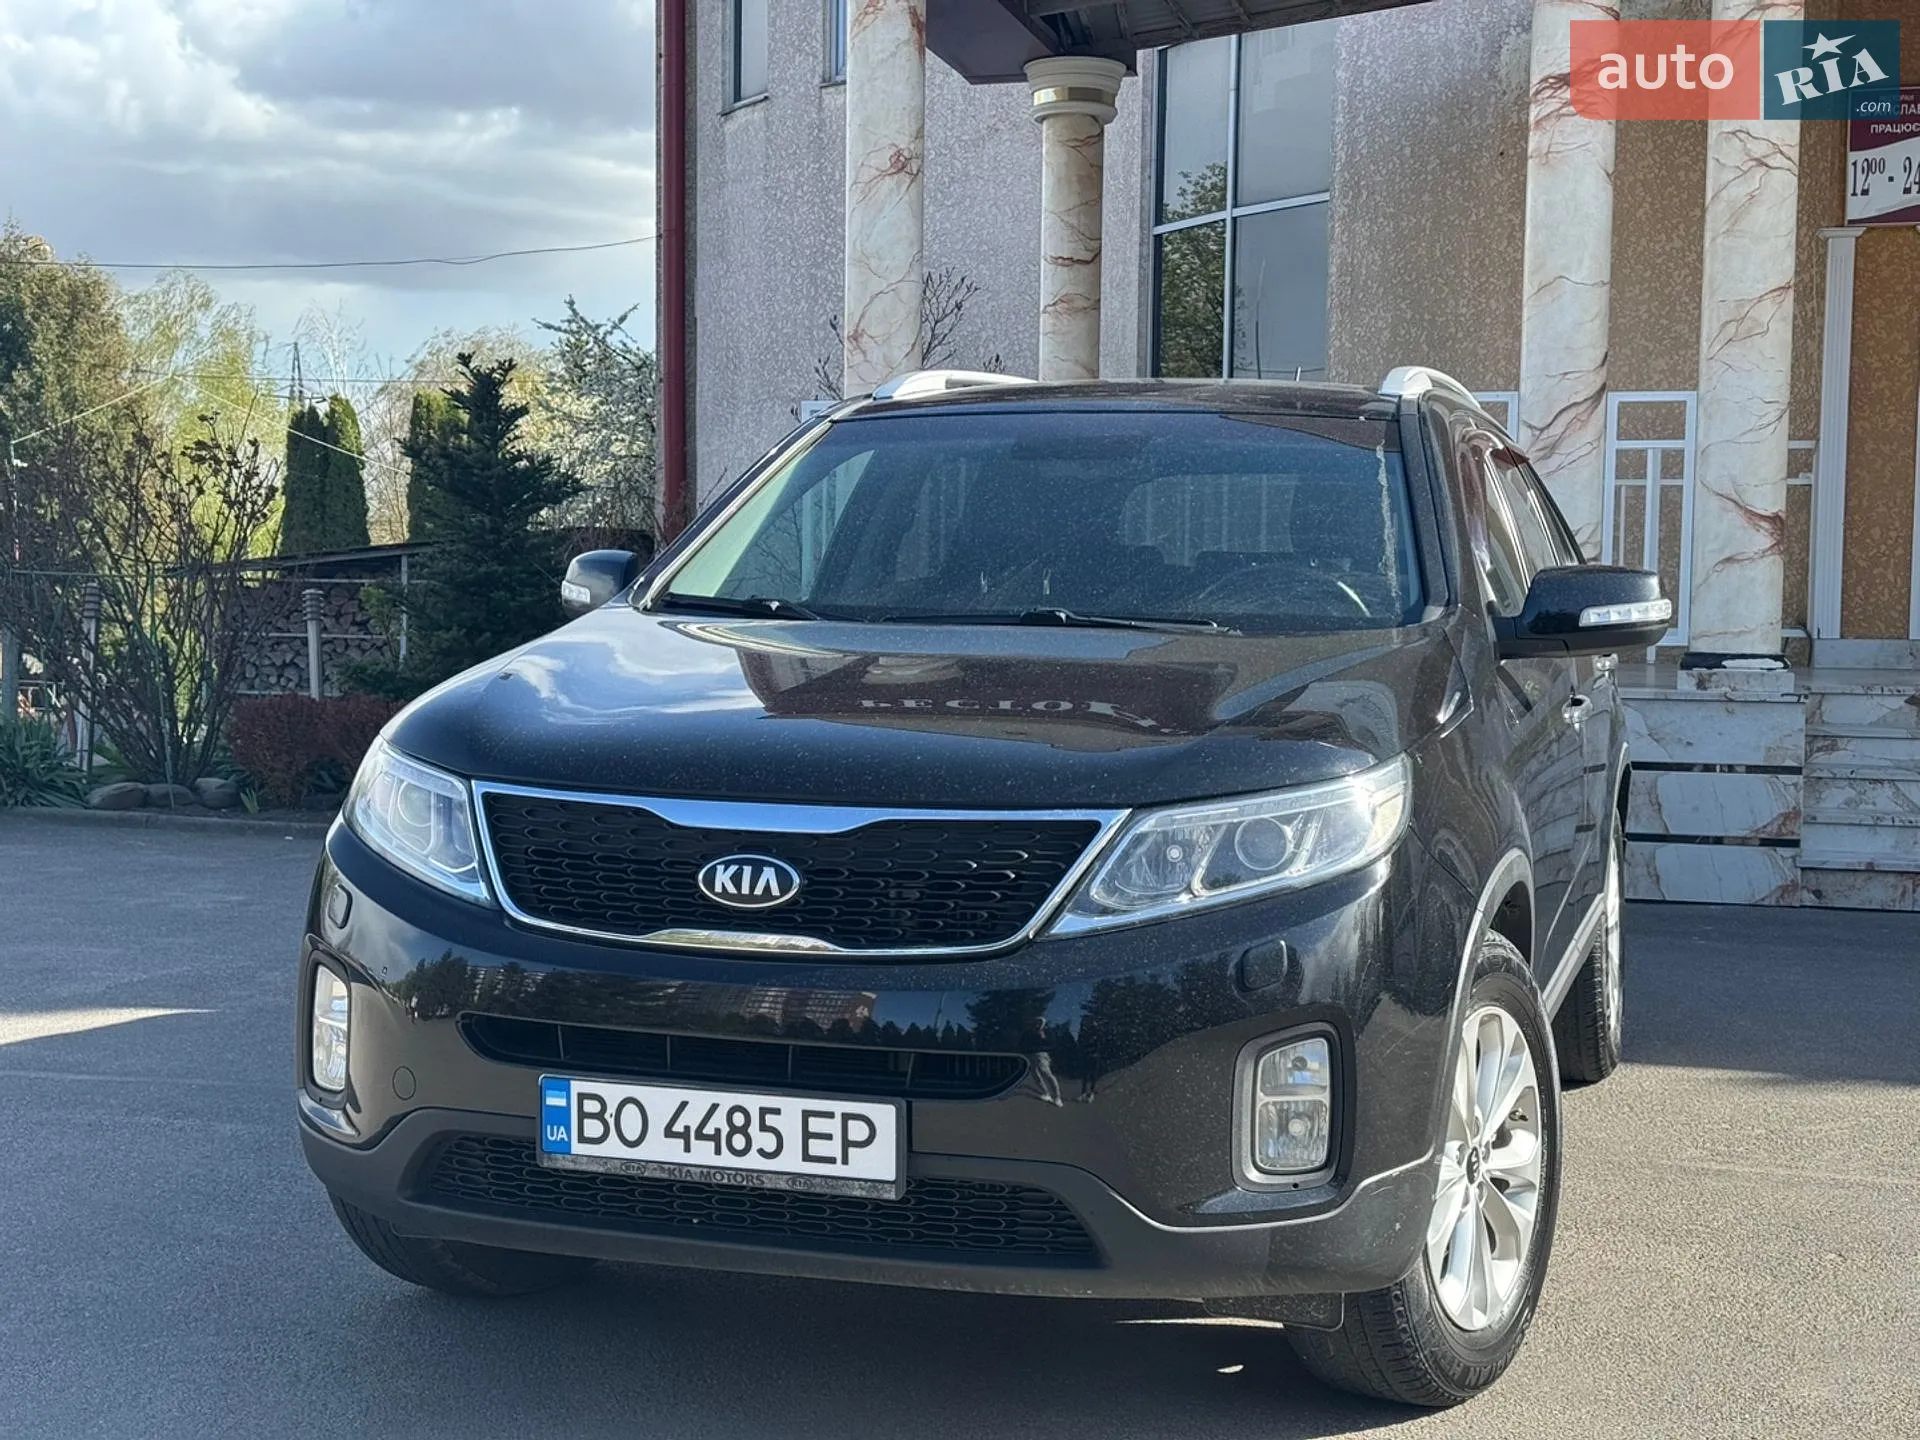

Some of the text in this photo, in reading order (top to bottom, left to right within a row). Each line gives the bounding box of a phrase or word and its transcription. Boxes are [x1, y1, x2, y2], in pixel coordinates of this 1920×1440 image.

[714, 864, 780, 896] KIA
[546, 1123, 568, 1142] UA
[576, 1092, 877, 1166] BO 4485 EP
[667, 1166, 697, 1181] KIA
[701, 1169, 765, 1187] MOTORS
